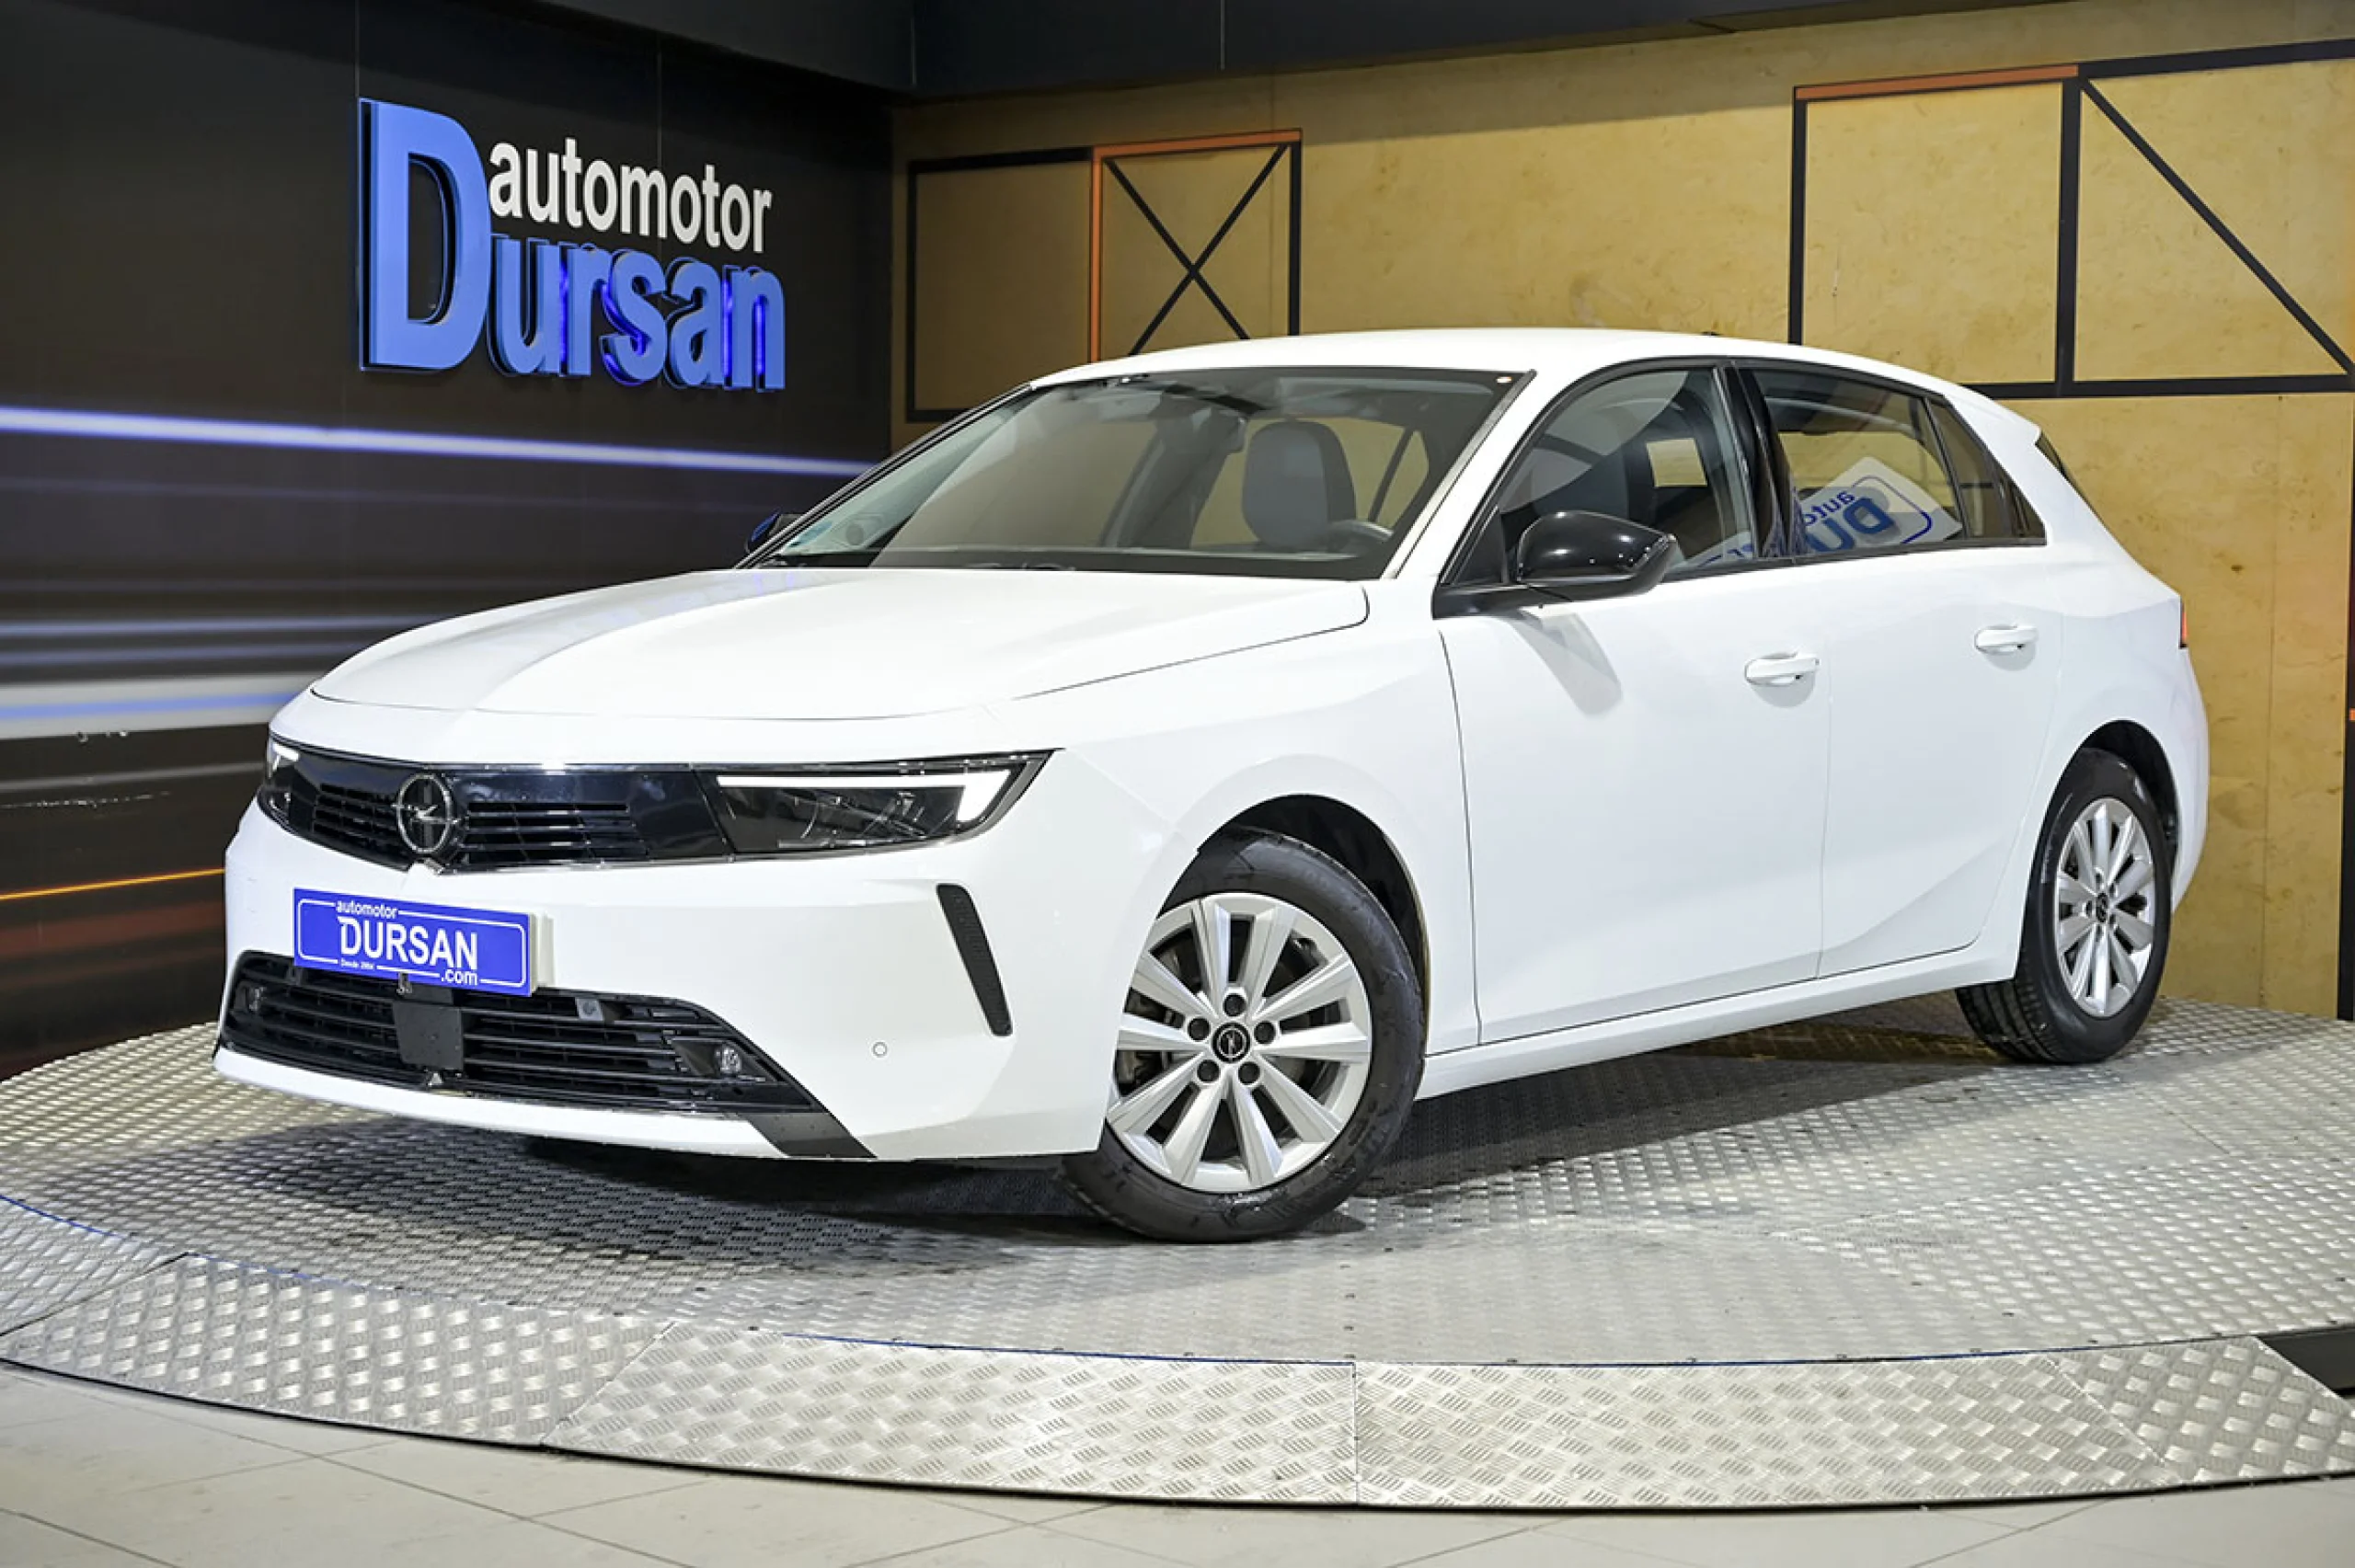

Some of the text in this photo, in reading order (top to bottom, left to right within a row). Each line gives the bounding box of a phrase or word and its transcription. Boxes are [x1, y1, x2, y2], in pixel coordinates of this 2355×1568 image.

[488, 137, 773, 253] automotor
[359, 97, 787, 393] Dursan
[336, 899, 399, 919] automotor
[337, 915, 478, 971] DURSAN
[441, 968, 478, 986] .com
